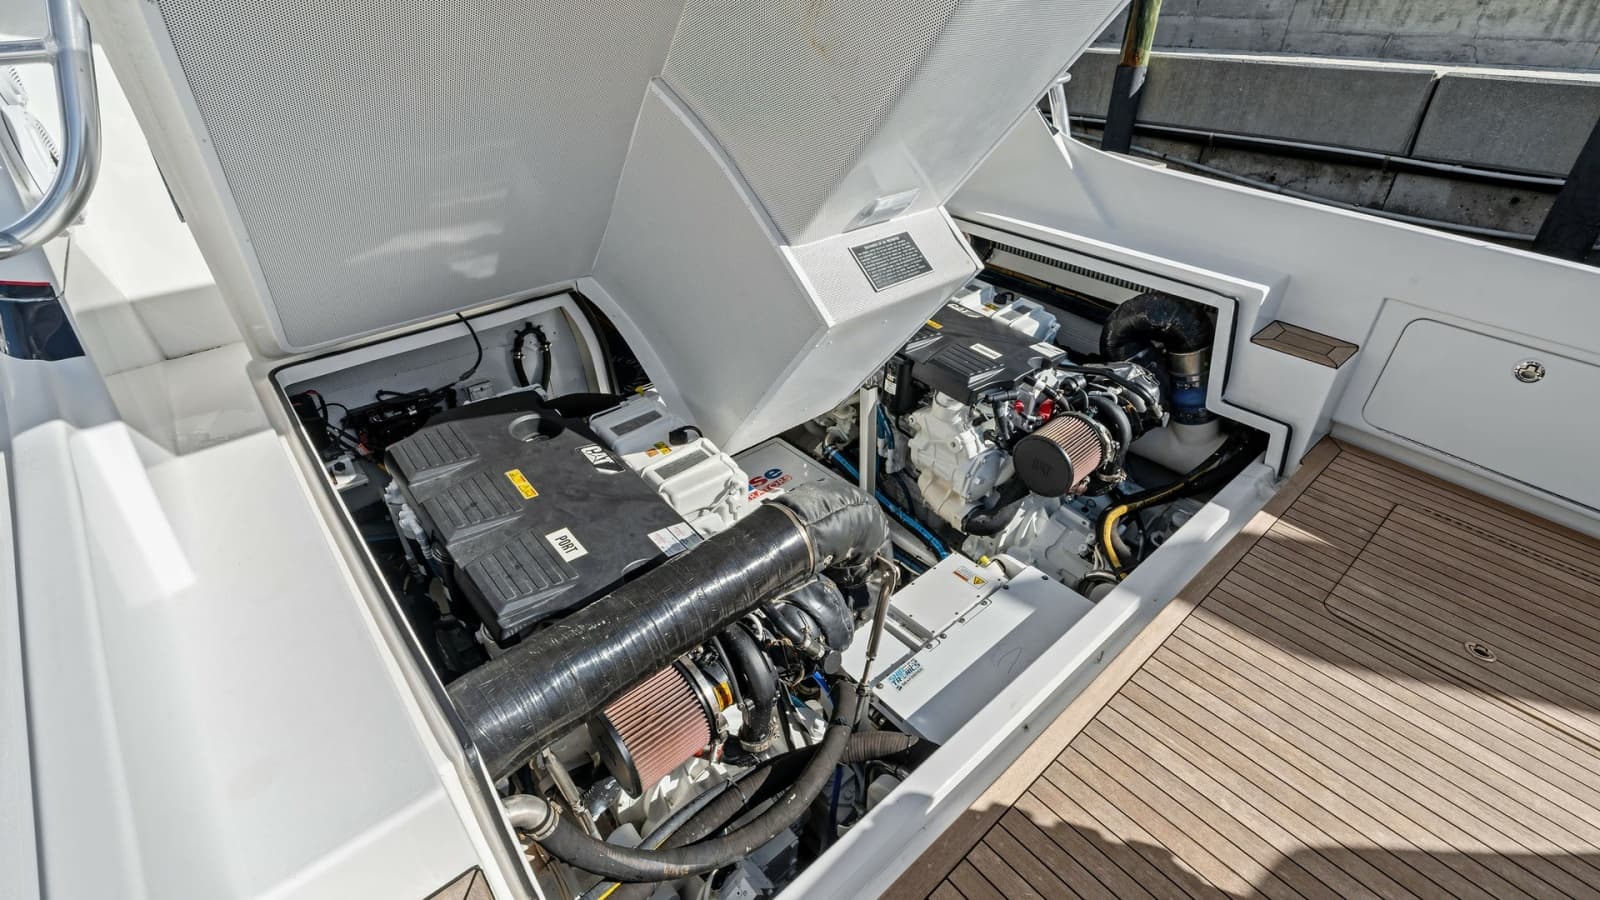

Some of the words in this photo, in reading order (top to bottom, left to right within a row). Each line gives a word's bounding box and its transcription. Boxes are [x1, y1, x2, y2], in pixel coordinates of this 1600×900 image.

[581, 445, 615, 465] CAT
[748, 468, 783, 488] se
[748, 474, 793, 501] RATORS
[555, 535, 579, 554] PORT
